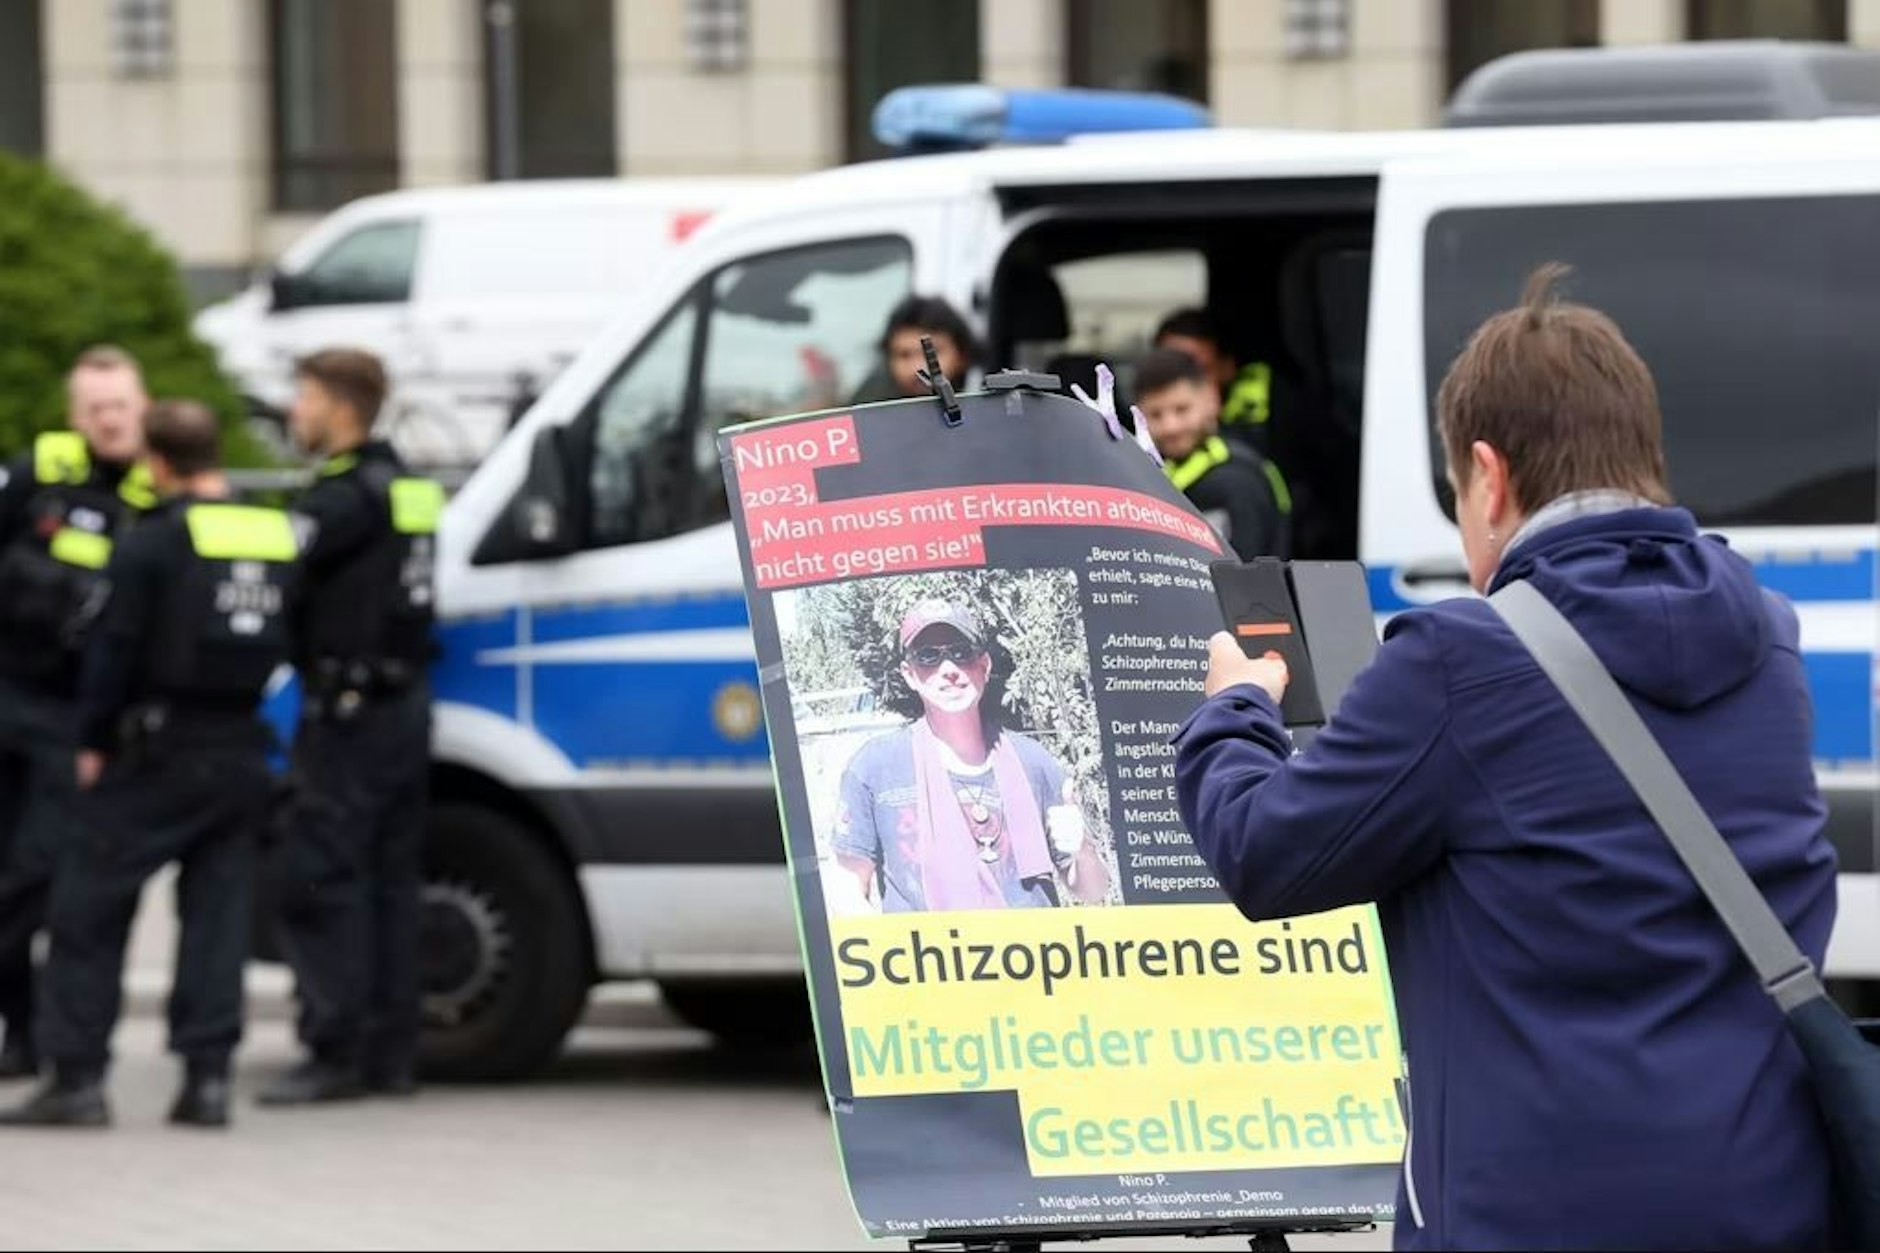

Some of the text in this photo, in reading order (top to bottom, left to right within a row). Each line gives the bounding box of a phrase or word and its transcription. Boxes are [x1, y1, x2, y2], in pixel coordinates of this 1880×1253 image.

[736, 427, 857, 471] Nino P.
[745, 483, 816, 508] 2023,
[832, 507, 903, 533] muss
[910, 496, 957, 523] mit
[962, 493, 1101, 520] Erkrankten
[1107, 498, 1187, 534] arbeiten
[757, 551, 826, 581] nicht
[832, 544, 918, 578] gegen
[1132, 547, 1151, 564] ich
[1154, 552, 1189, 569] meine
[1088, 569, 1137, 585] erhielt,
[1139, 572, 1172, 588] sagte
[1174, 575, 1199, 589] eine
[1092, 590, 1139, 604] zu mir:
[1170, 634, 1186, 649] du
[1102, 655, 1198, 673] Schizophrenen
[1111, 720, 1180, 735] Der Mann
[1115, 741, 1177, 760] ängstlich
[1117, 764, 1132, 778] in
[1134, 763, 1158, 778] der
[1121, 785, 1164, 801] seiner
[1123, 808, 1180, 823] Mensch
[1127, 830, 1151, 845] Die
[837, 922, 1369, 996] Schizophrene sind
[849, 1014, 1384, 1089] Mitglieder unserer
[1026, 1095, 1403, 1160] Gesellschaft!
[1119, 1173, 1170, 1187] Nino P.
[1039, 1194, 1100, 1210] Mitglied
[1102, 1193, 1131, 1206] von
[885, 1219, 919, 1231] Eine
[922, 1217, 970, 1230] Aktion
[972, 1217, 1001, 1227] von
[1105, 1209, 1134, 1222] und
[1137, 1208, 1201, 1220] Paranoia
[1348, 1203, 1374, 1215] das
